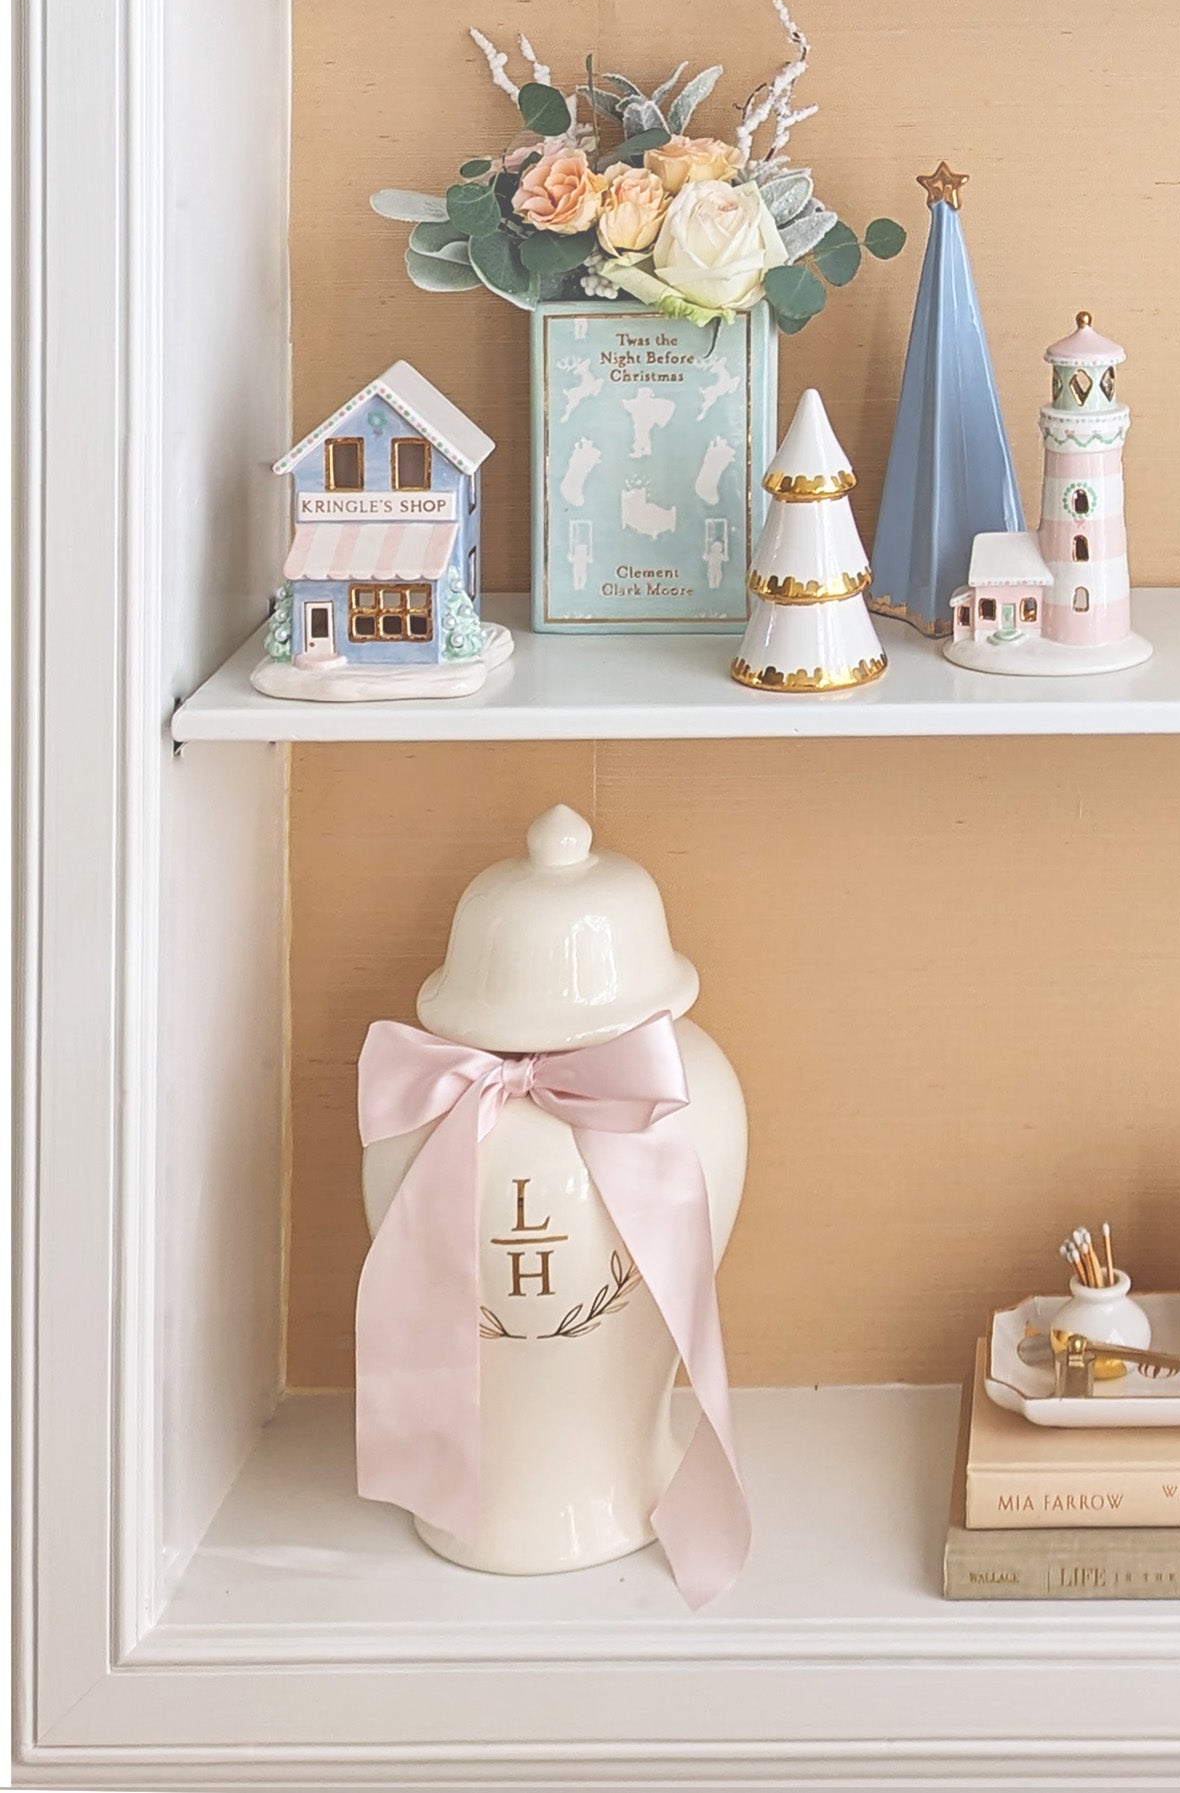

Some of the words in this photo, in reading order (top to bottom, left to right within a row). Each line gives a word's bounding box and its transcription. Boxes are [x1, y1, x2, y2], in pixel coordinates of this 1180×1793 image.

[616, 333, 650, 346] Twas
[655, 333, 678, 346] the
[600, 350, 641, 368] Night
[646, 351, 694, 364] Before
[610, 369, 684, 382] Christmas
[302, 499, 393, 513] KRINGLE'S
[400, 499, 447, 513] SHOP
[616, 565, 680, 579] Clement
[602, 582, 641, 596] Clark
[646, 582, 694, 596] Moore
[510, 1178, 550, 1232] L
[507, 1250, 556, 1297] H
[998, 1494, 1034, 1511] MIA
[1044, 1494, 1124, 1511] FARROW
[969, 1571, 1020, 1584] WALLACE
[1060, 1567, 1106, 1587] LIFE
